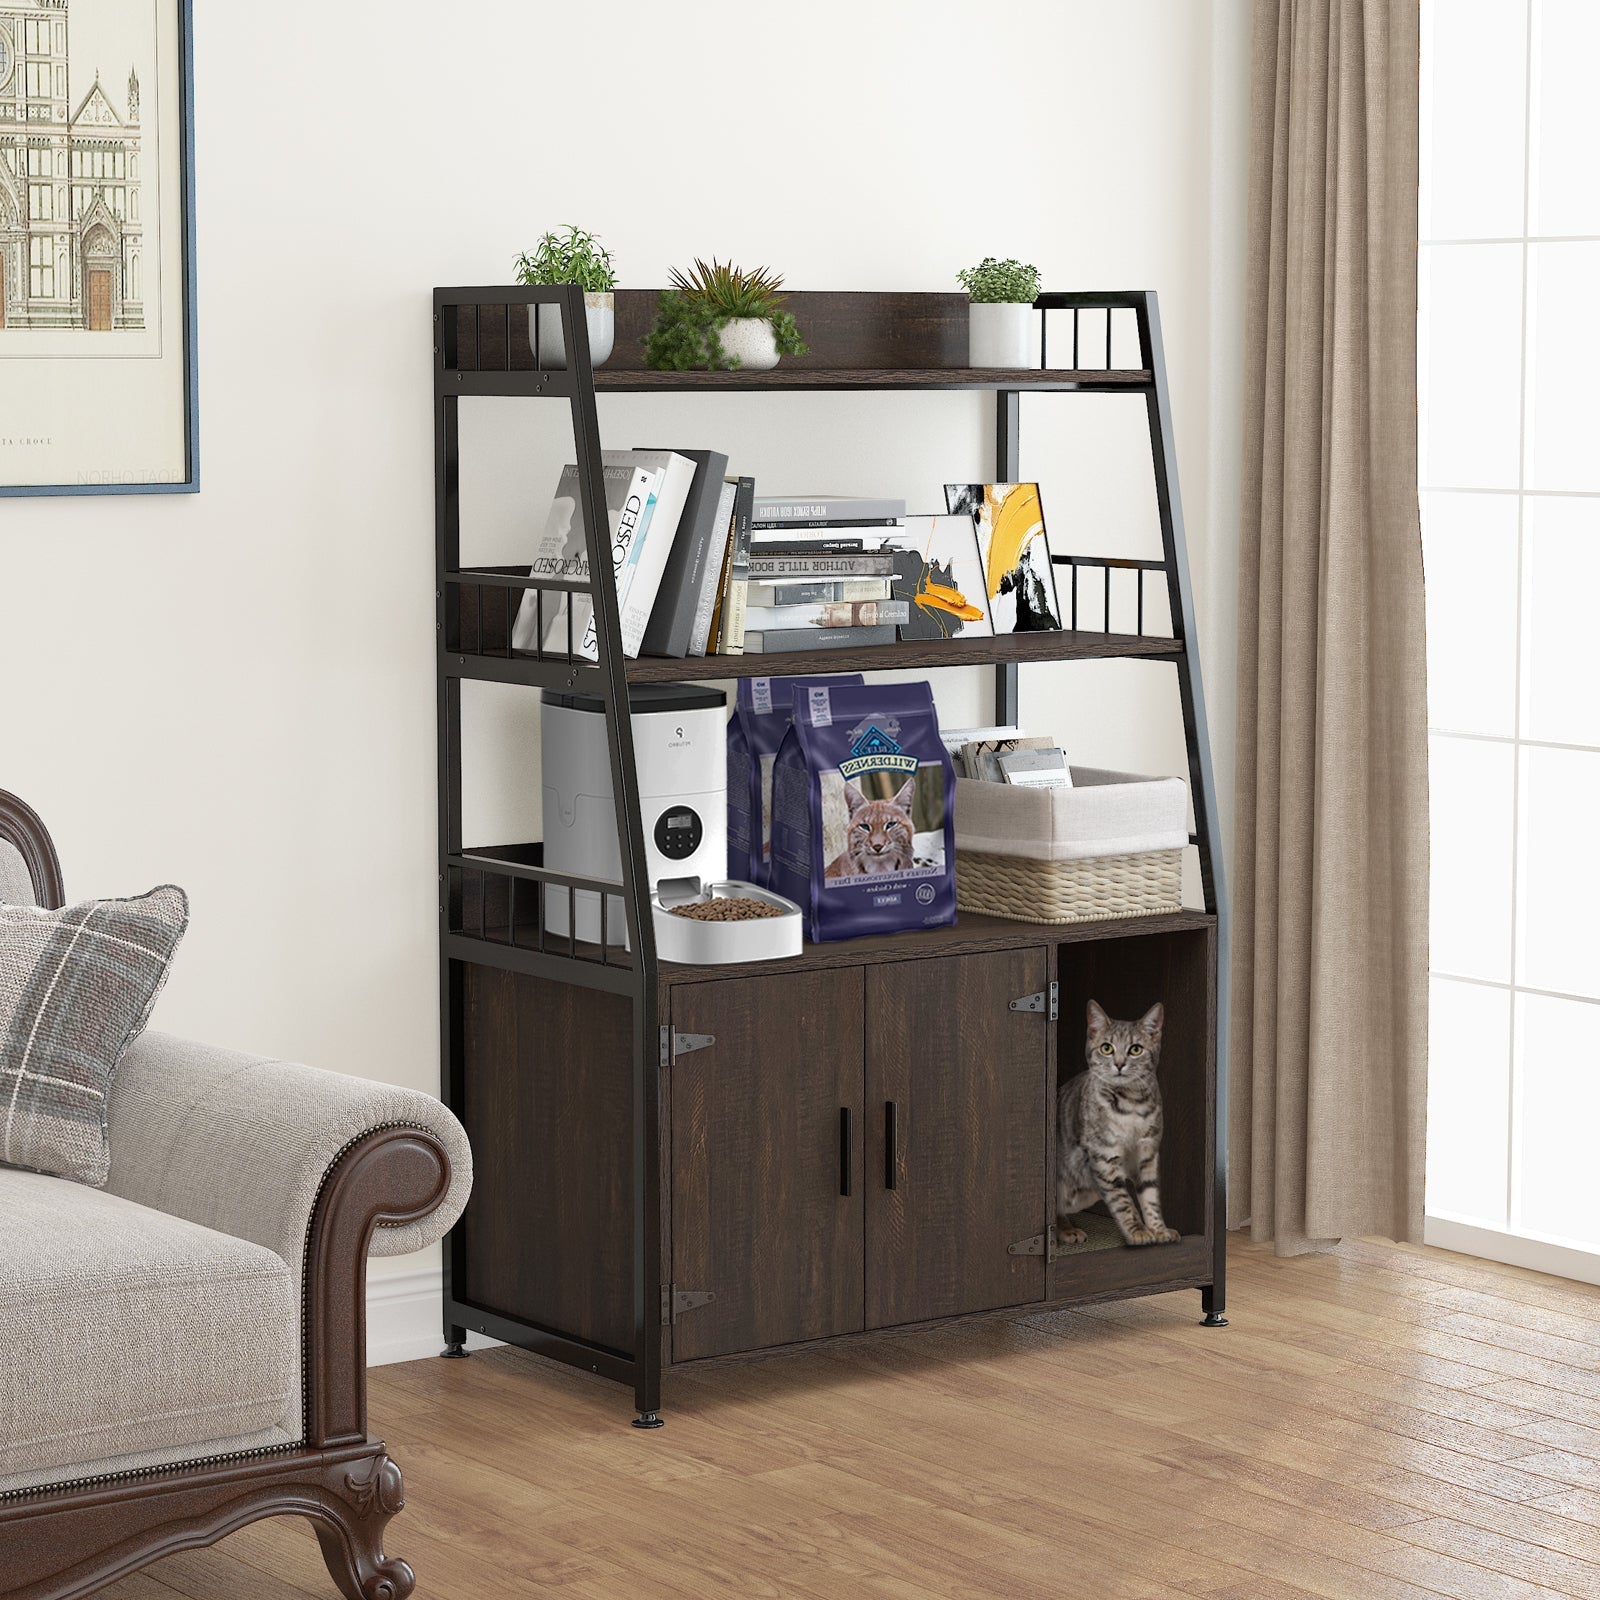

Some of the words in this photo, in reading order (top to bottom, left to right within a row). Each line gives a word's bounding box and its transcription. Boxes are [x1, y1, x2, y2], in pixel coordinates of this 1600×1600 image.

[532, 557, 590, 576] ARCROSSED
[748, 562, 774, 572] BOOK
[778, 561, 809, 572] TITLE
[812, 561, 855, 571] AUTHOR
